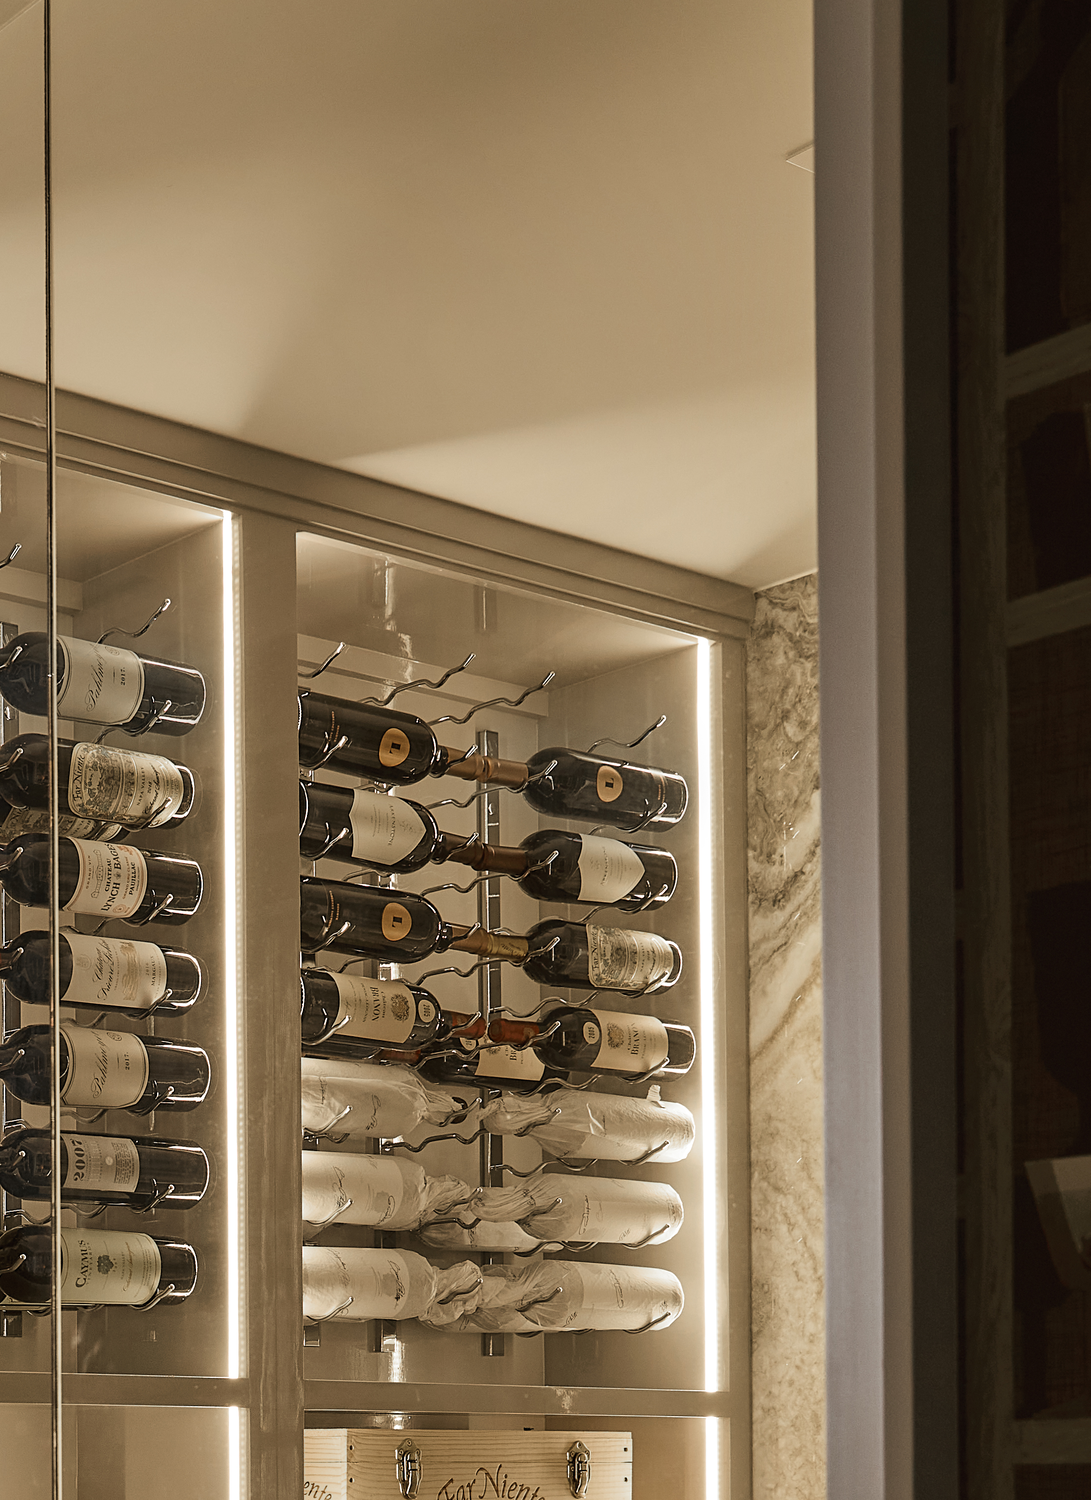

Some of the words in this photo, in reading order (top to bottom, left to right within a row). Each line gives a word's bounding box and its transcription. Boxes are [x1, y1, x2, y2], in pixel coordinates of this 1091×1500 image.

[73, 755, 85, 784] Niente
[73, 788, 83, 802] Far
[101, 882, 121, 911] LYNCH
[370, 986, 381, 1021] BRANON
[70, 1139, 85, 1181] 2007
[75, 1240, 88, 1288] CAYMUS
